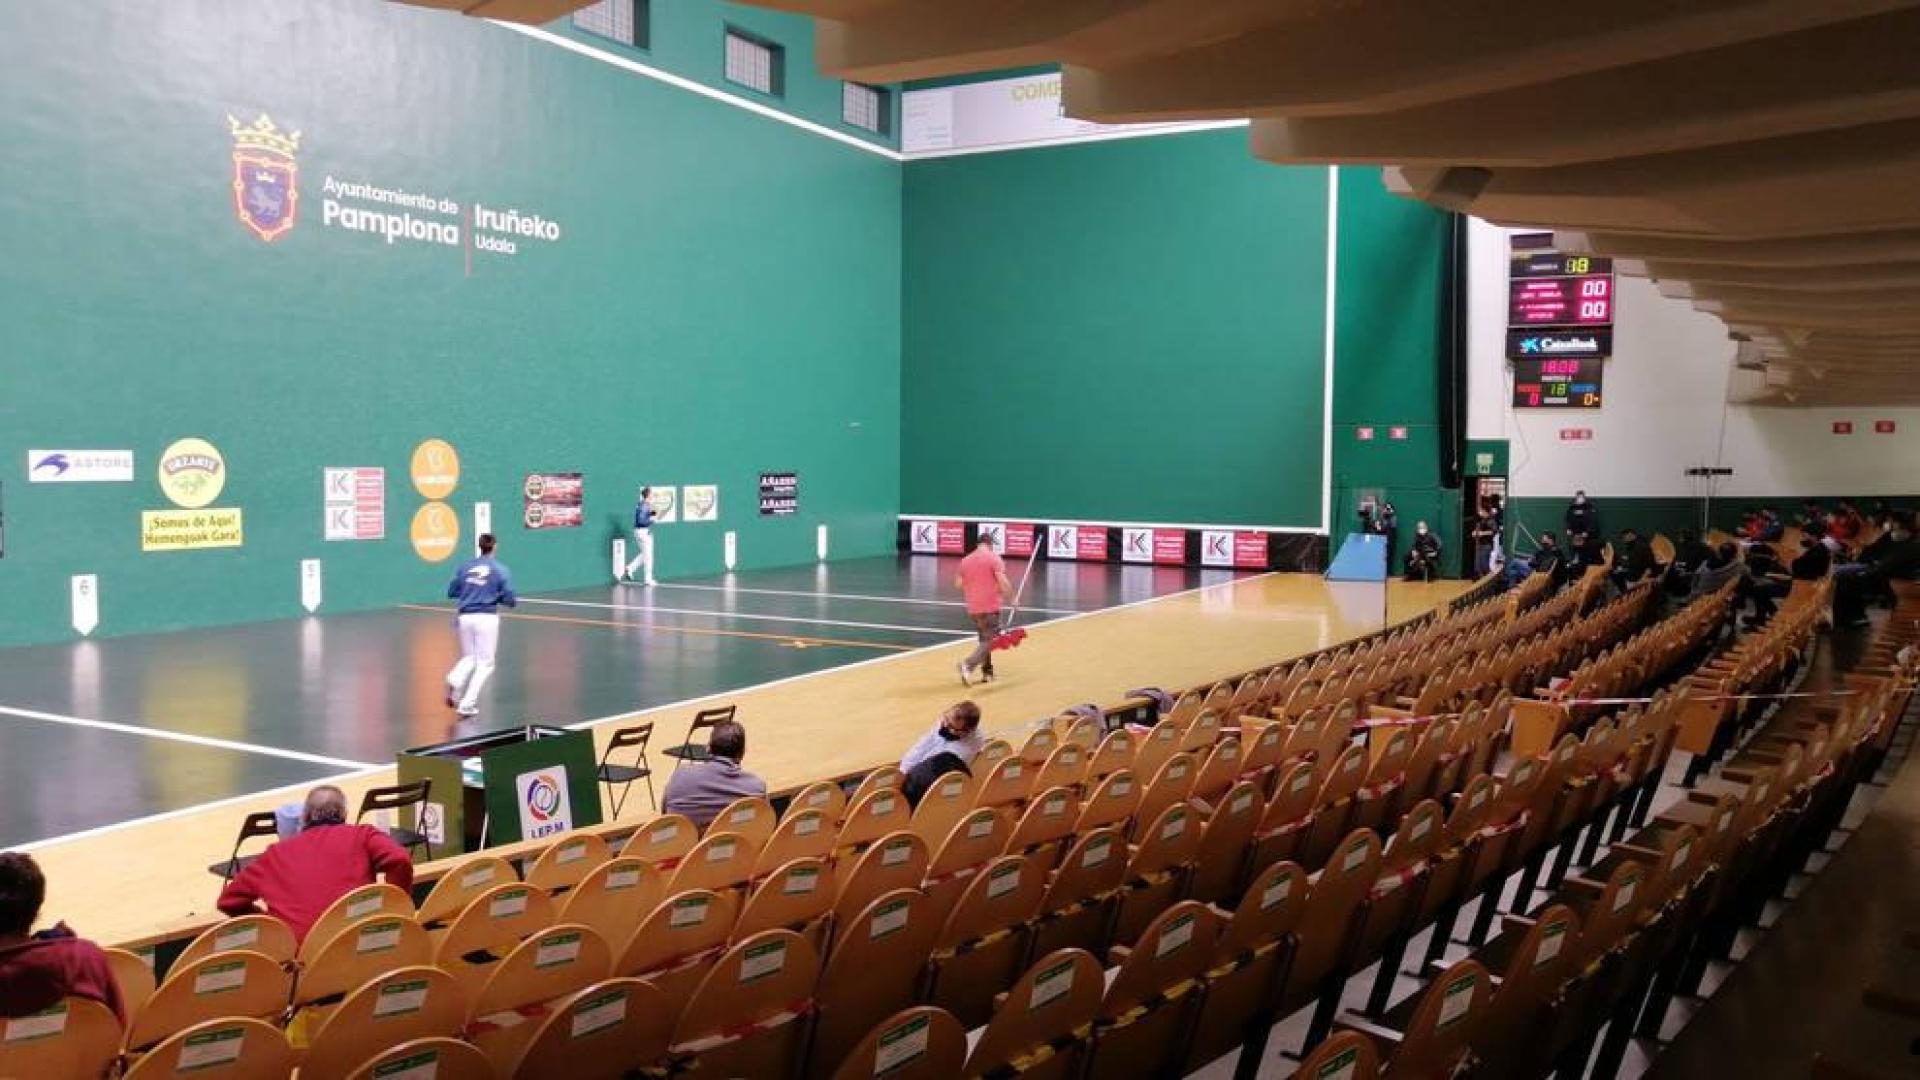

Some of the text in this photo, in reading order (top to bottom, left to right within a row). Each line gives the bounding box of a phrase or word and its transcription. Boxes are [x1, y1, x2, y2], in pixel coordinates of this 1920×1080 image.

[323, 175, 458, 215] Ayuntamiento de
[323, 199, 459, 244] Pamplona
[475, 203, 560, 241] Iruñeko
[475, 235, 517, 254] Udala
[1582, 280, 1607, 297] 00
[1581, 301, 1606, 318] 00
